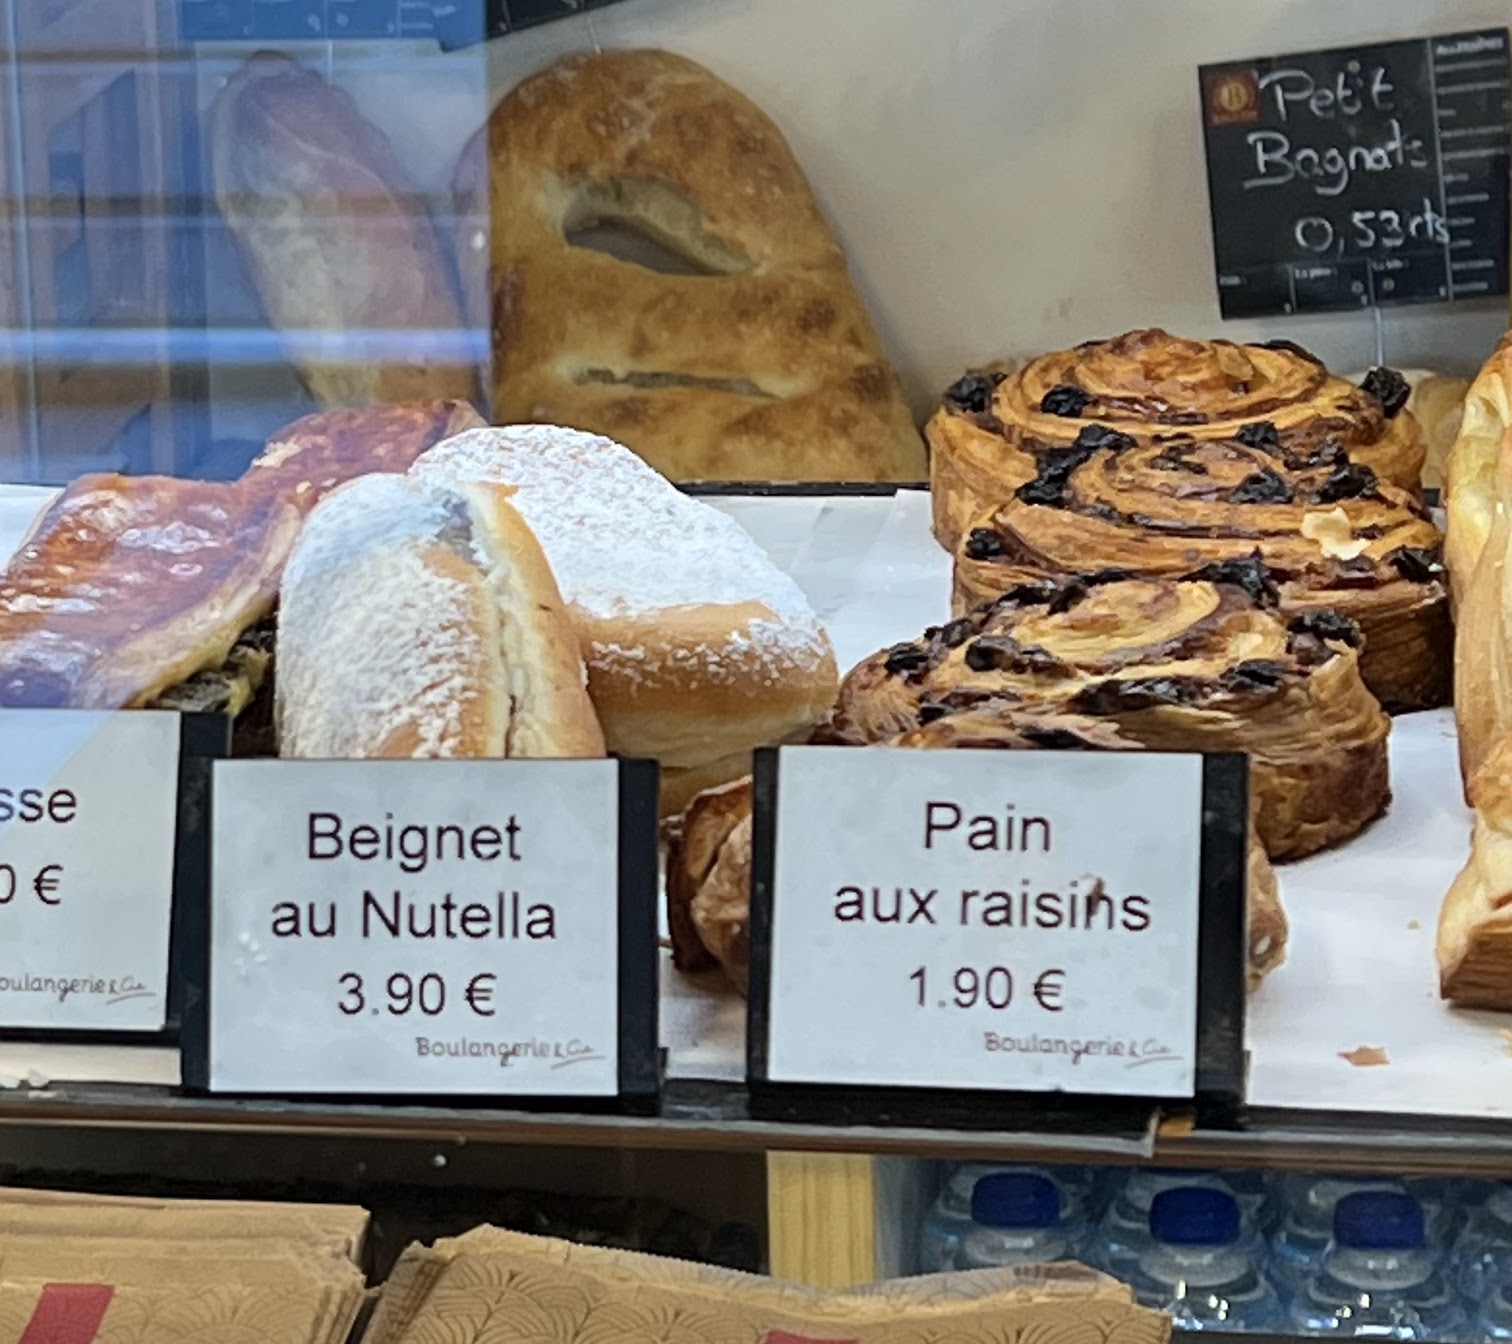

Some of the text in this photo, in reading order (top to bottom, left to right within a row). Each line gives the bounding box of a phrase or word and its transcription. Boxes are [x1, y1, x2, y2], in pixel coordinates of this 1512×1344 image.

[1258, 67, 1395, 122] Petit
[307, 811, 522, 874] Beignet
[923, 800, 1052, 853] Pain
[33, 864, 64, 906] €
[833, 878, 1152, 933] aux raisins
[270, 889, 557, 940] au Nutella
[337, 972, 498, 1017] 3.90 €
[909, 965, 1066, 1012] 1.90 €
